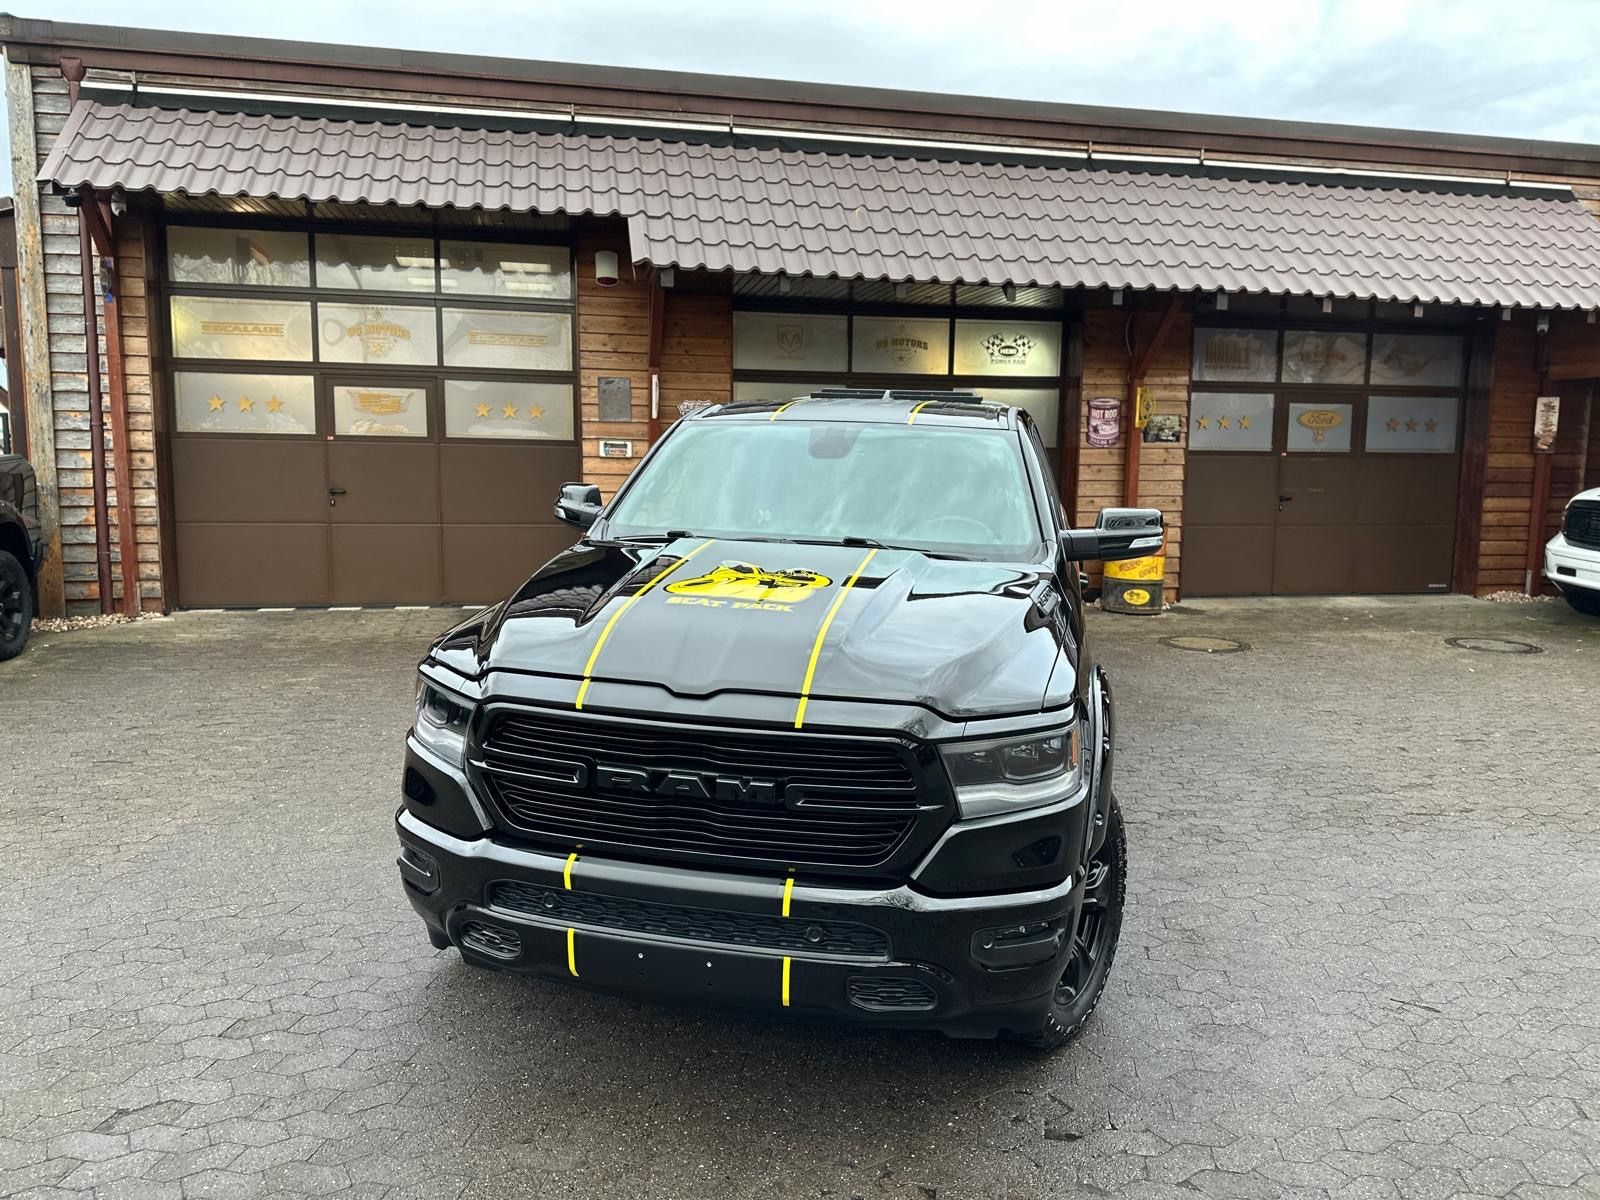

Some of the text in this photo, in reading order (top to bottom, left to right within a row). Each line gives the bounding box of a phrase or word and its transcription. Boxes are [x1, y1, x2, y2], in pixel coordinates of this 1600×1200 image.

[201, 324, 284, 334] ESCALADE
[891, 337, 929, 351] MOTORS
[1091, 408, 1118, 419] HOT ROD
[1307, 412, 1335, 425] Ford
[665, 596, 795, 613] SCAT PACK
[596, 765, 777, 805] RAM
